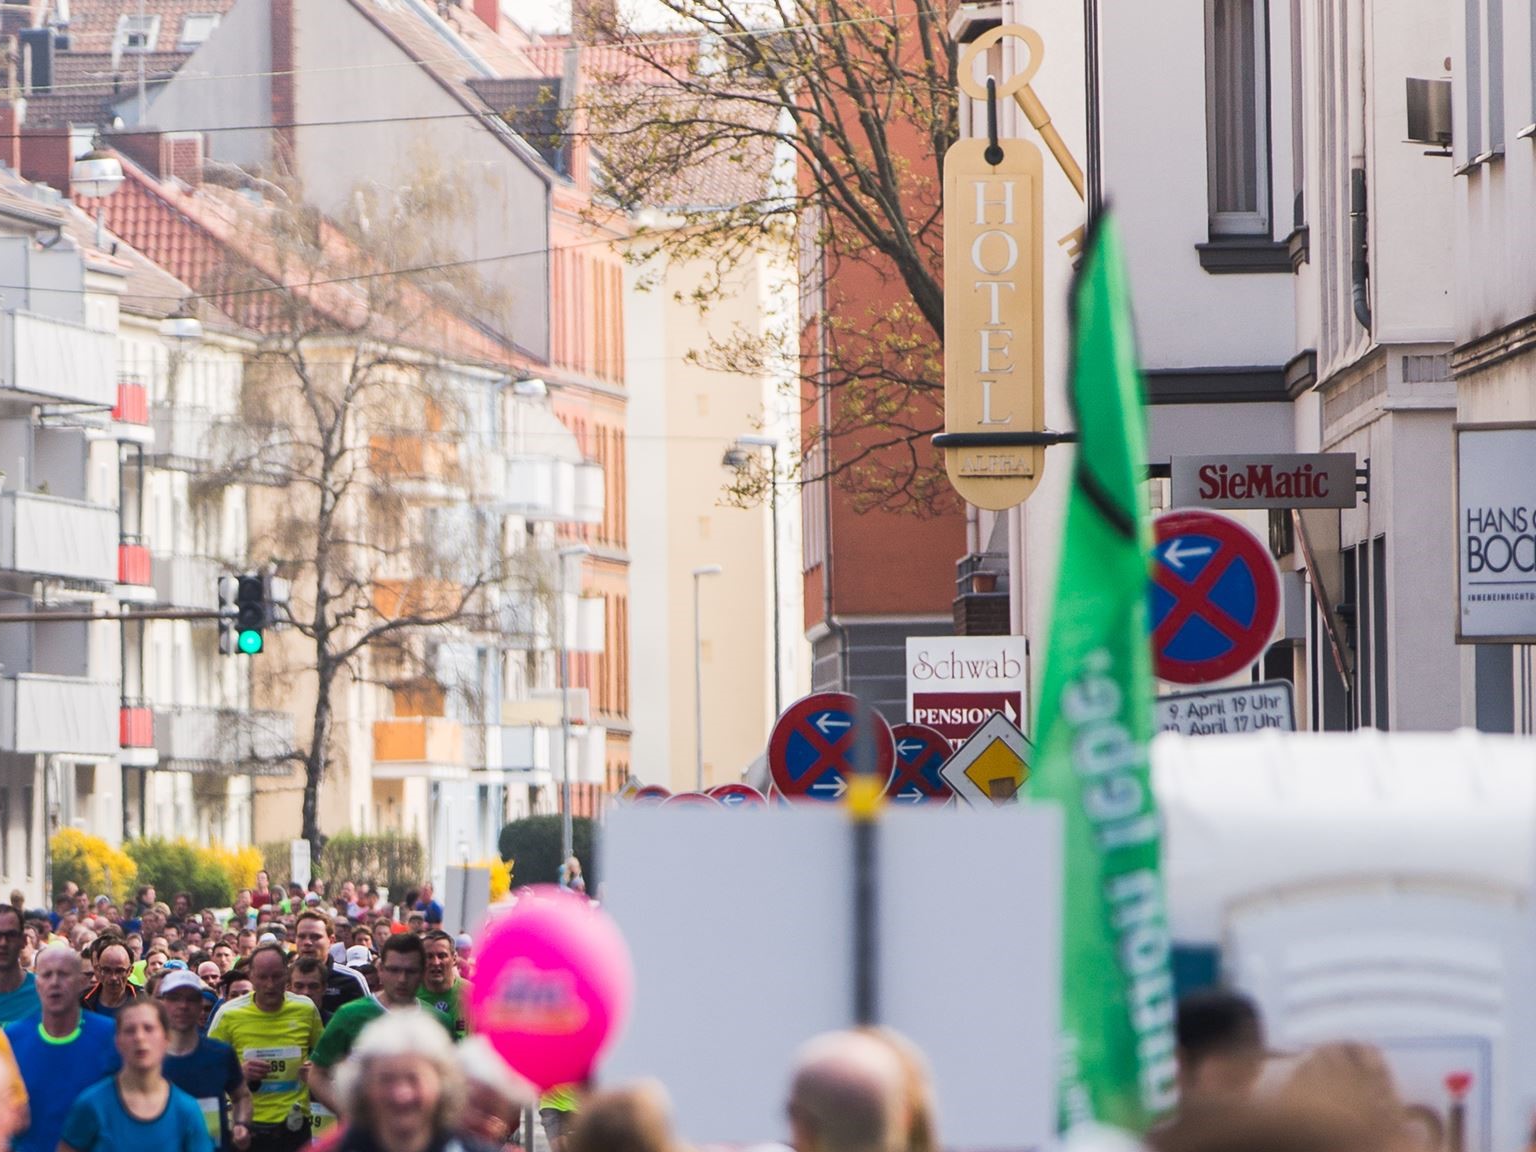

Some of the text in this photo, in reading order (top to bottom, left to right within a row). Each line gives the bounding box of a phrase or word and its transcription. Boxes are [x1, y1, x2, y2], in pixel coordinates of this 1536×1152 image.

[970, 180, 1019, 426] HOTEL
[961, 454, 1030, 473] ALPHA
[1199, 463, 1330, 500] SieMatic
[1467, 506, 1528, 533] HANS
[1467, 534, 1536, 573] BOC
[912, 649, 1022, 680] Schwab
[1187, 699, 1226, 720] April
[1232, 696, 1247, 713] 19
[1251, 693, 1282, 710] Uhr
[1190, 718, 1227, 736] April
[1253, 713, 1283, 730] Uhr
